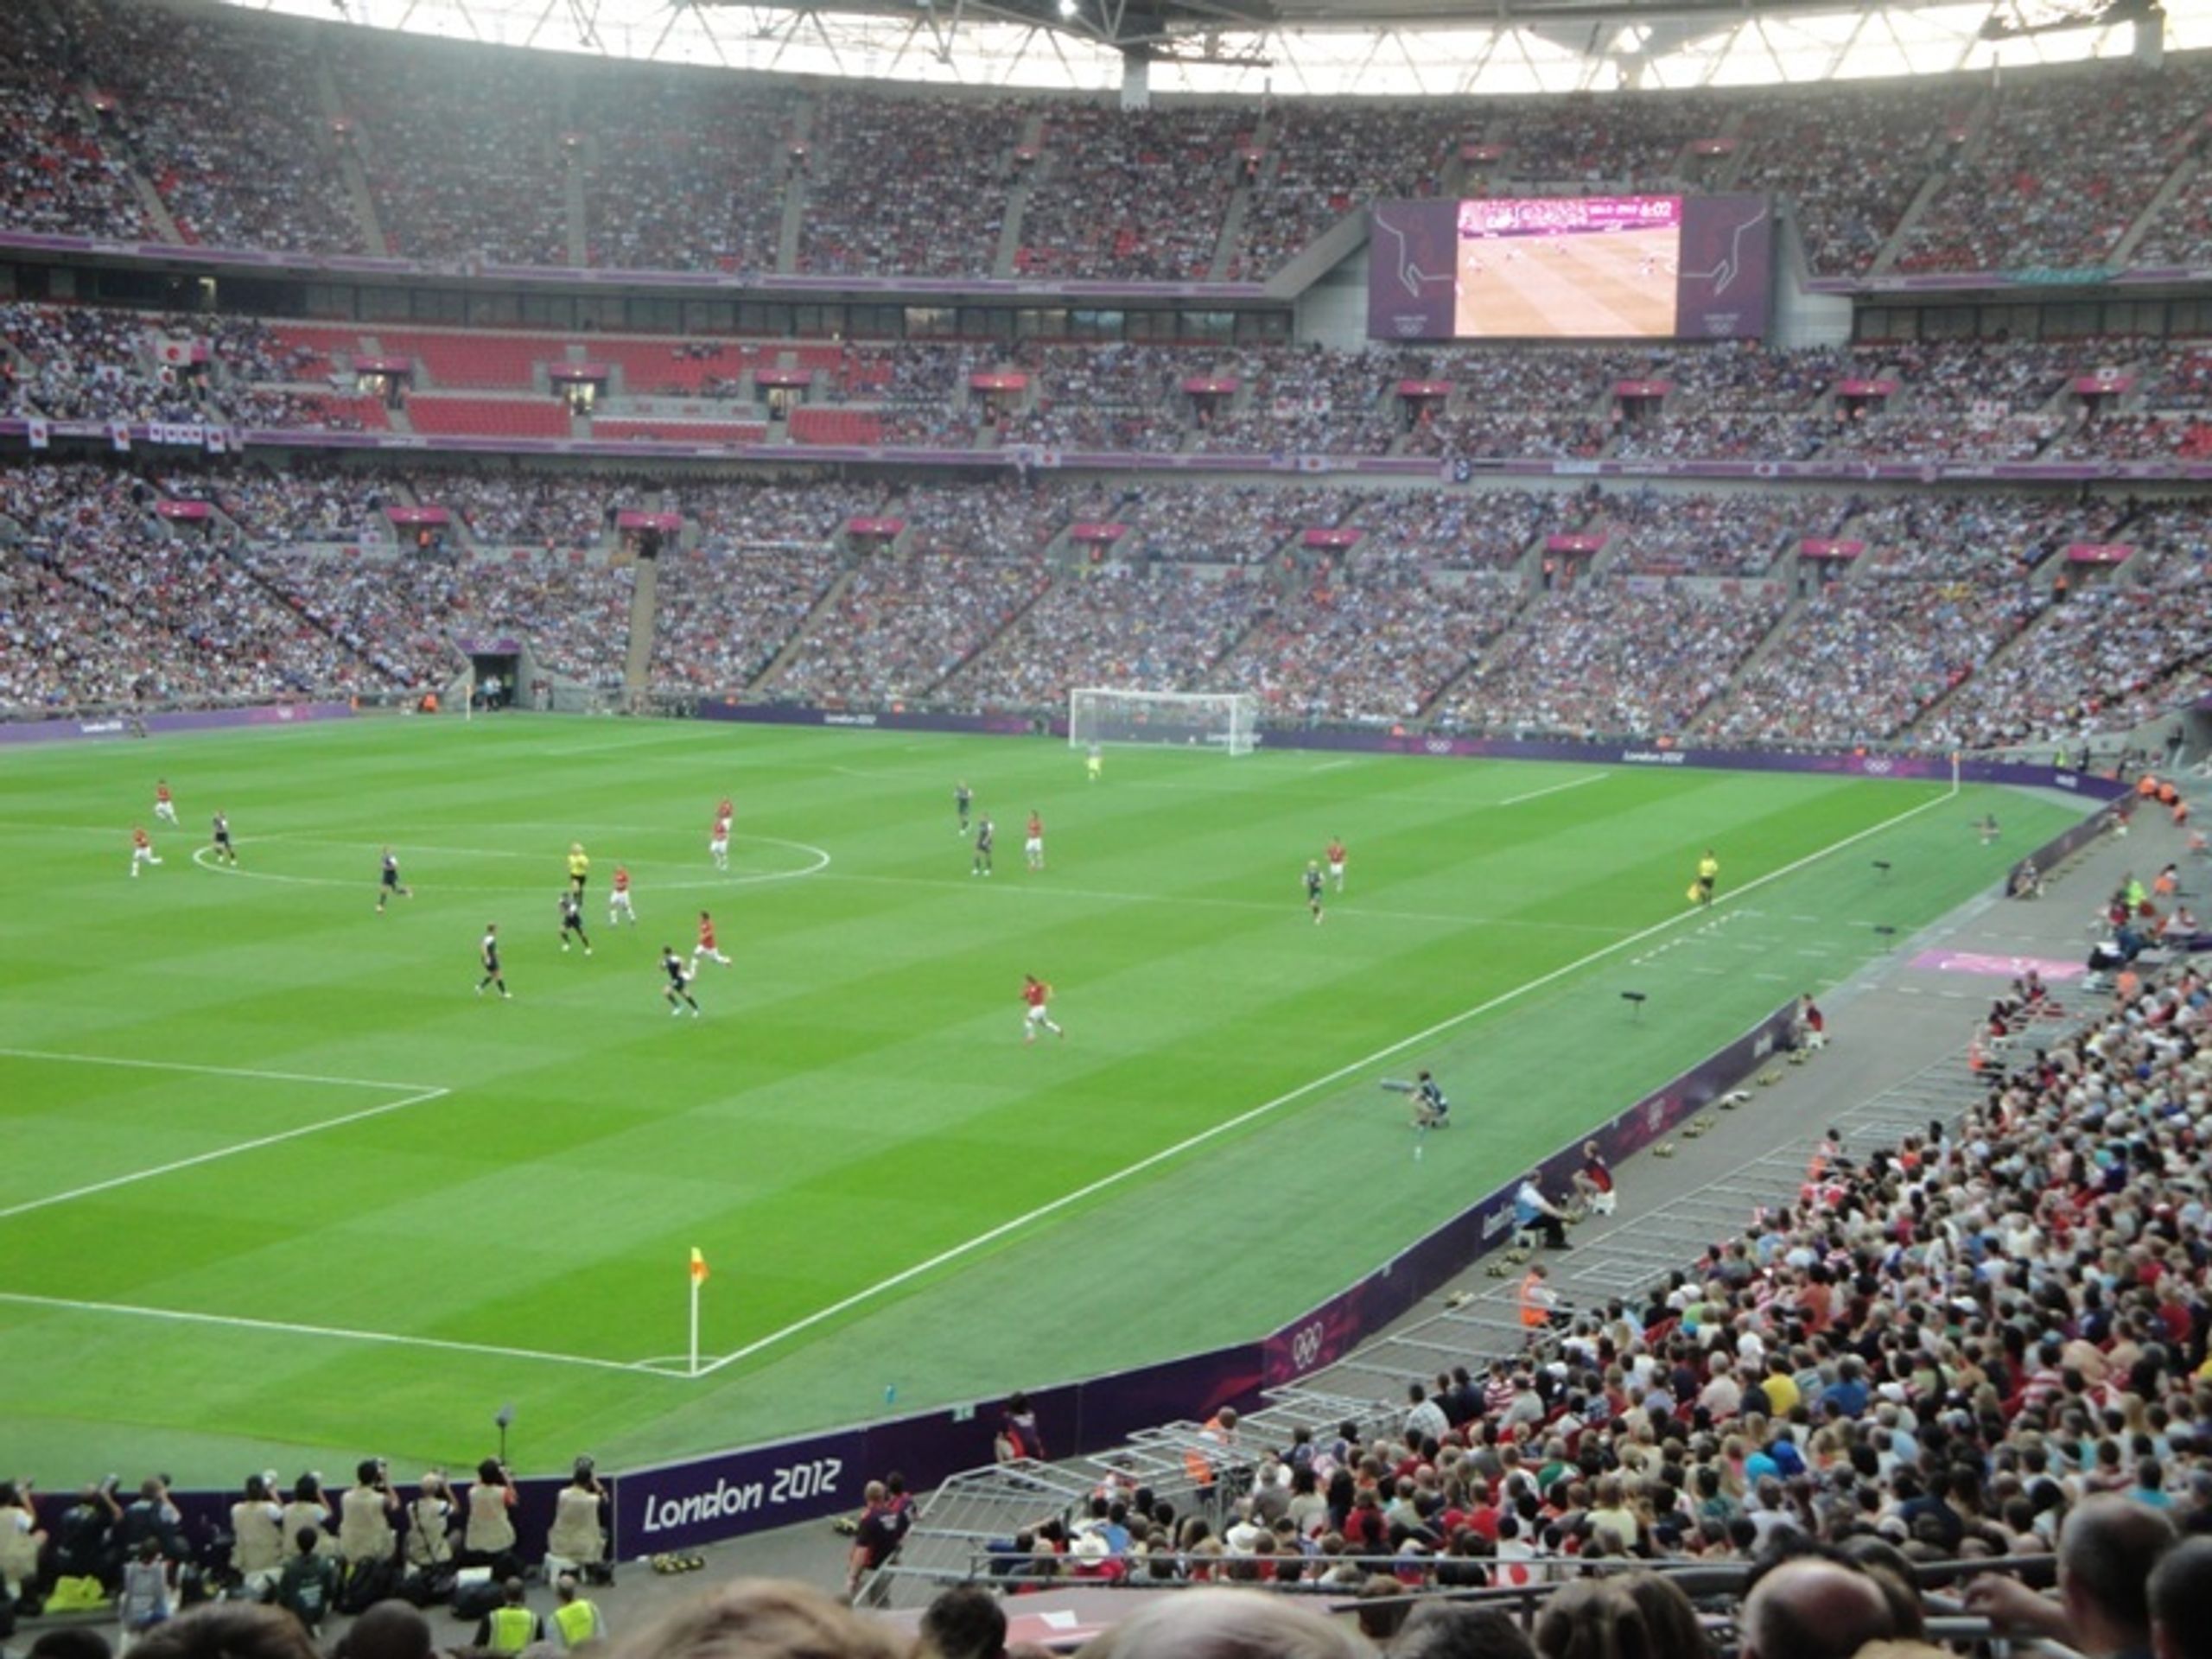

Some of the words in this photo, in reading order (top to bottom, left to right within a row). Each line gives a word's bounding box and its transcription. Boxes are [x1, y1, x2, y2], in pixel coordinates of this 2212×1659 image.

[1623, 749, 1660, 762] London
[1661, 751, 1685, 765] 2012
[643, 1478, 764, 1533] London
[769, 1458, 842, 1503] 2012
